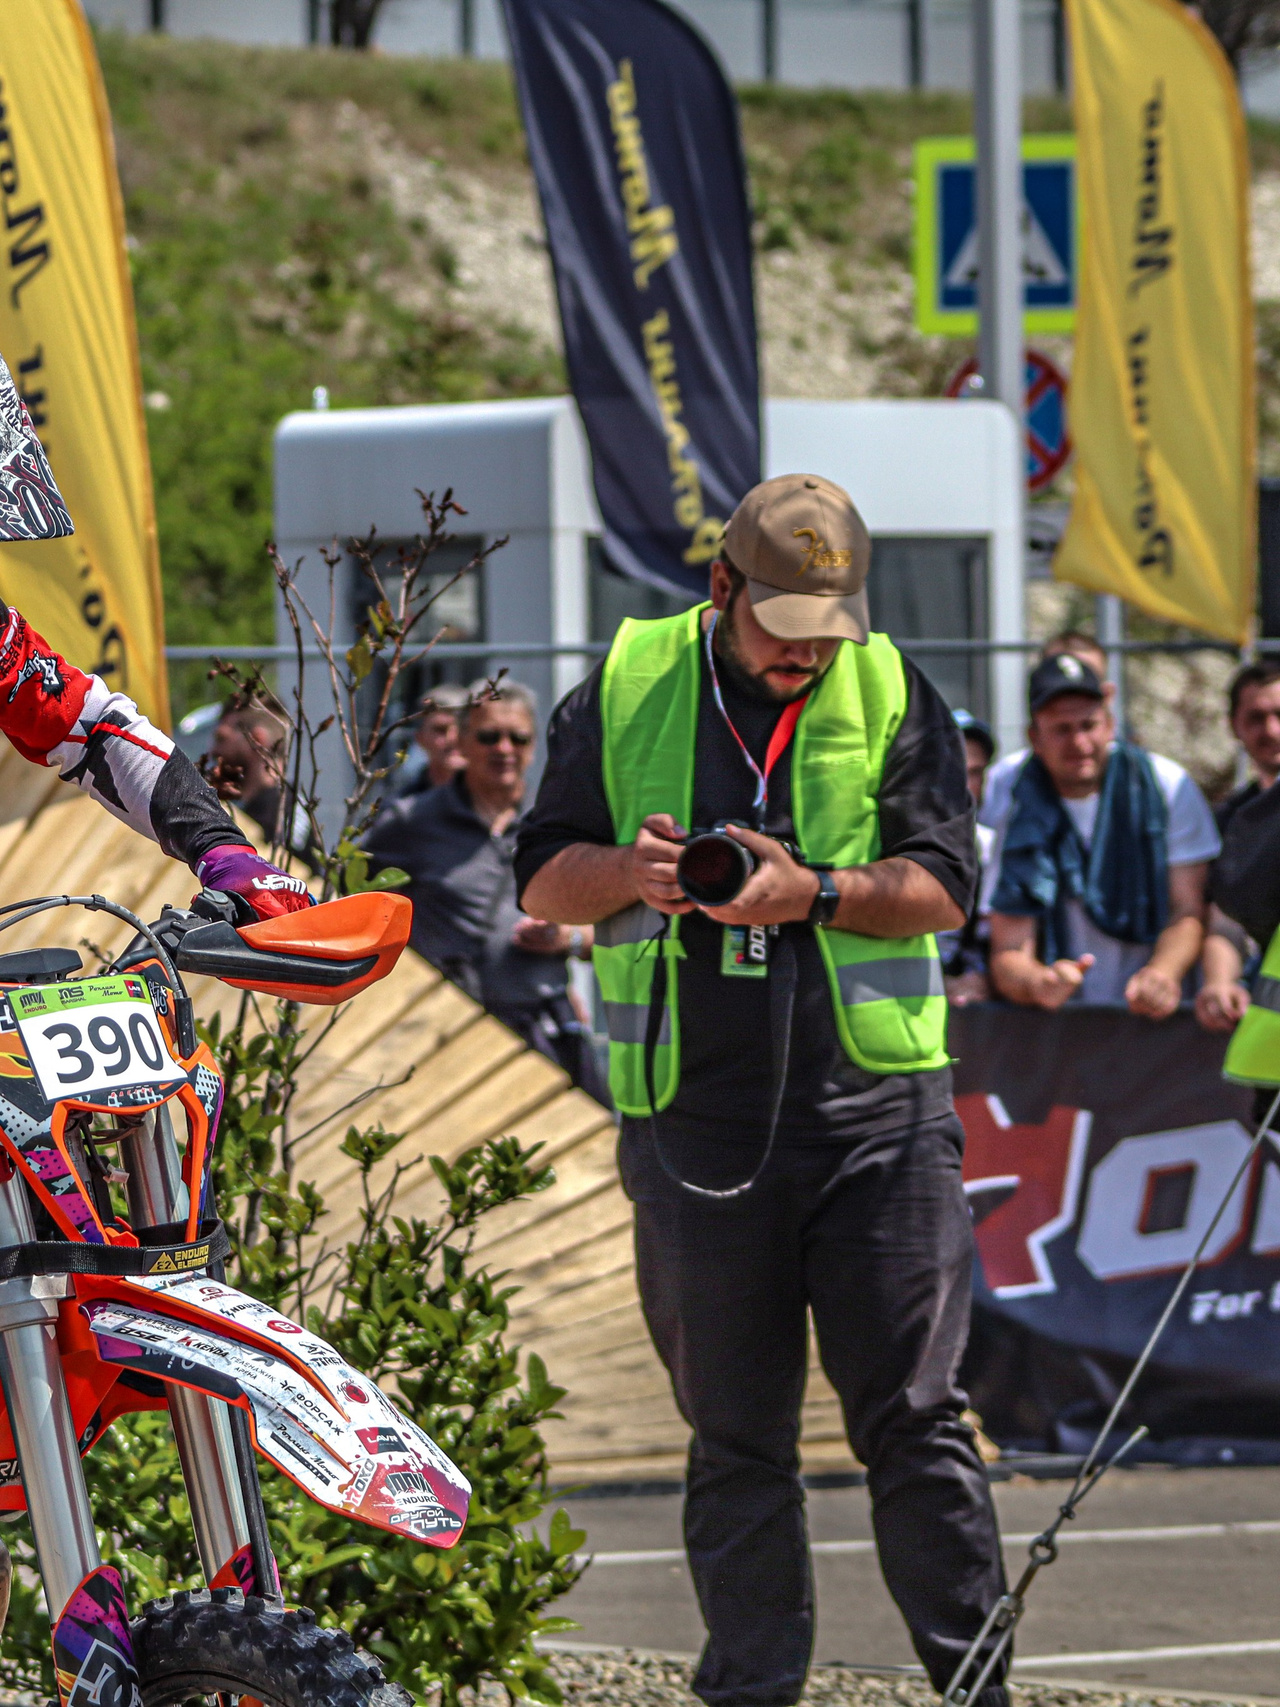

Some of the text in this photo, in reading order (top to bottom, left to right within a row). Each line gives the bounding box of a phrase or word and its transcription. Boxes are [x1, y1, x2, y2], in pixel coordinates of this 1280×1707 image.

[24, 1005, 47, 1014] ENDURO
[42, 1012, 164, 1084] 390
[174, 1244, 210, 1262] ENDURO
[177, 1255, 209, 1270] ELEMENT
[193, 1341, 231, 1358] KENDA
[296, 1392, 345, 1437] ФОРСАЖ
[395, 1495, 439, 1505] ENDURO
[390, 1507, 444, 1525] ДРУГОЙ
[410, 1516, 463, 1532] ПУТЬ
